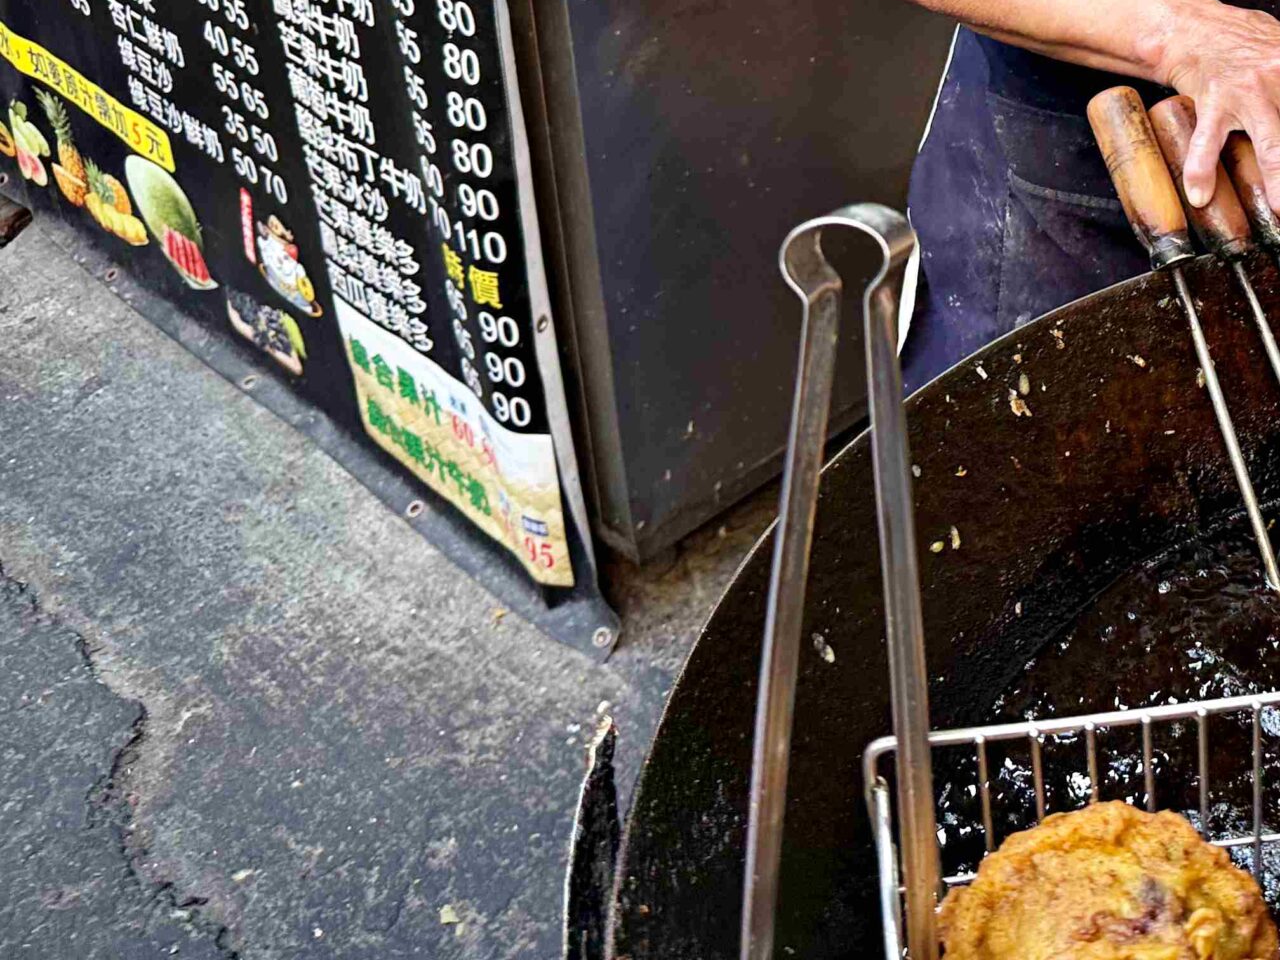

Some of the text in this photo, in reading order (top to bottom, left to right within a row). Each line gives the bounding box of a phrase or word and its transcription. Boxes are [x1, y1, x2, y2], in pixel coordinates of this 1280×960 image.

[204, 20, 229, 58] 40
[231, 37, 260, 77] 55
[395, 19, 422, 64] 55
[443, 42, 481, 87] 80
[118, 34, 279, 162] 綠豆沙 35 50
[212, 62, 239, 100] 55
[241, 82, 269, 120] 65
[277, 20, 493, 179] 芒果牛奶 55 80
[404, 66, 429, 111] 55
[446, 91, 488, 133] 80
[231, 147, 258, 184] 50
[260, 165, 288, 204] 70
[457, 183, 500, 221] 90
[429, 196, 451, 240] 70
[453, 220, 507, 264] 110
[442, 242, 503, 309] 特價
[478, 311, 520, 348] 90
[485, 352, 526, 388] 90
[492, 391, 531, 427] 90
[524, 536, 555, 569] 95
